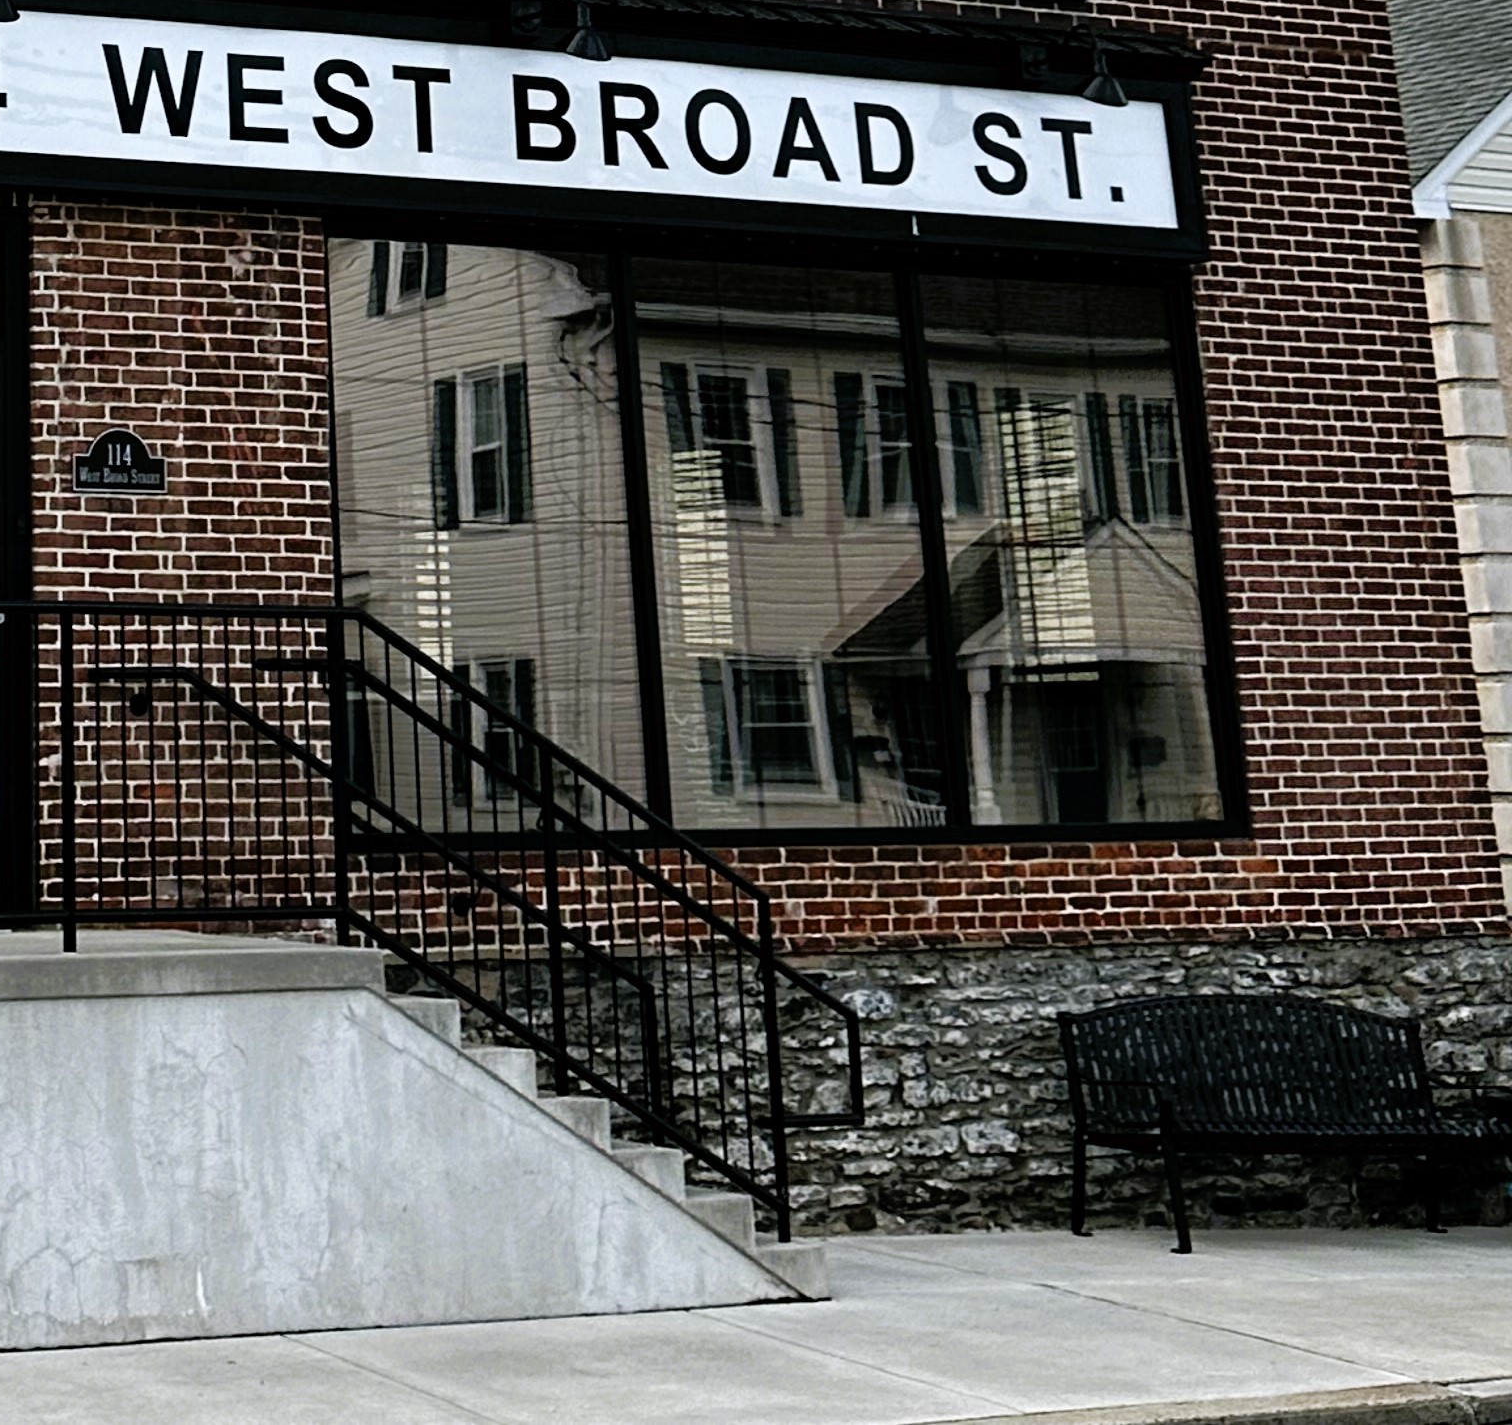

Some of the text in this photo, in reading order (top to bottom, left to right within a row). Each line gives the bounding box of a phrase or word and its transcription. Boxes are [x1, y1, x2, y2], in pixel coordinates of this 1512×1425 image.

[101, 43, 451, 154] WEST
[512, 73, 915, 186] BROAD
[973, 111, 1125, 203] ST.
[108, 443, 131, 466] 114
